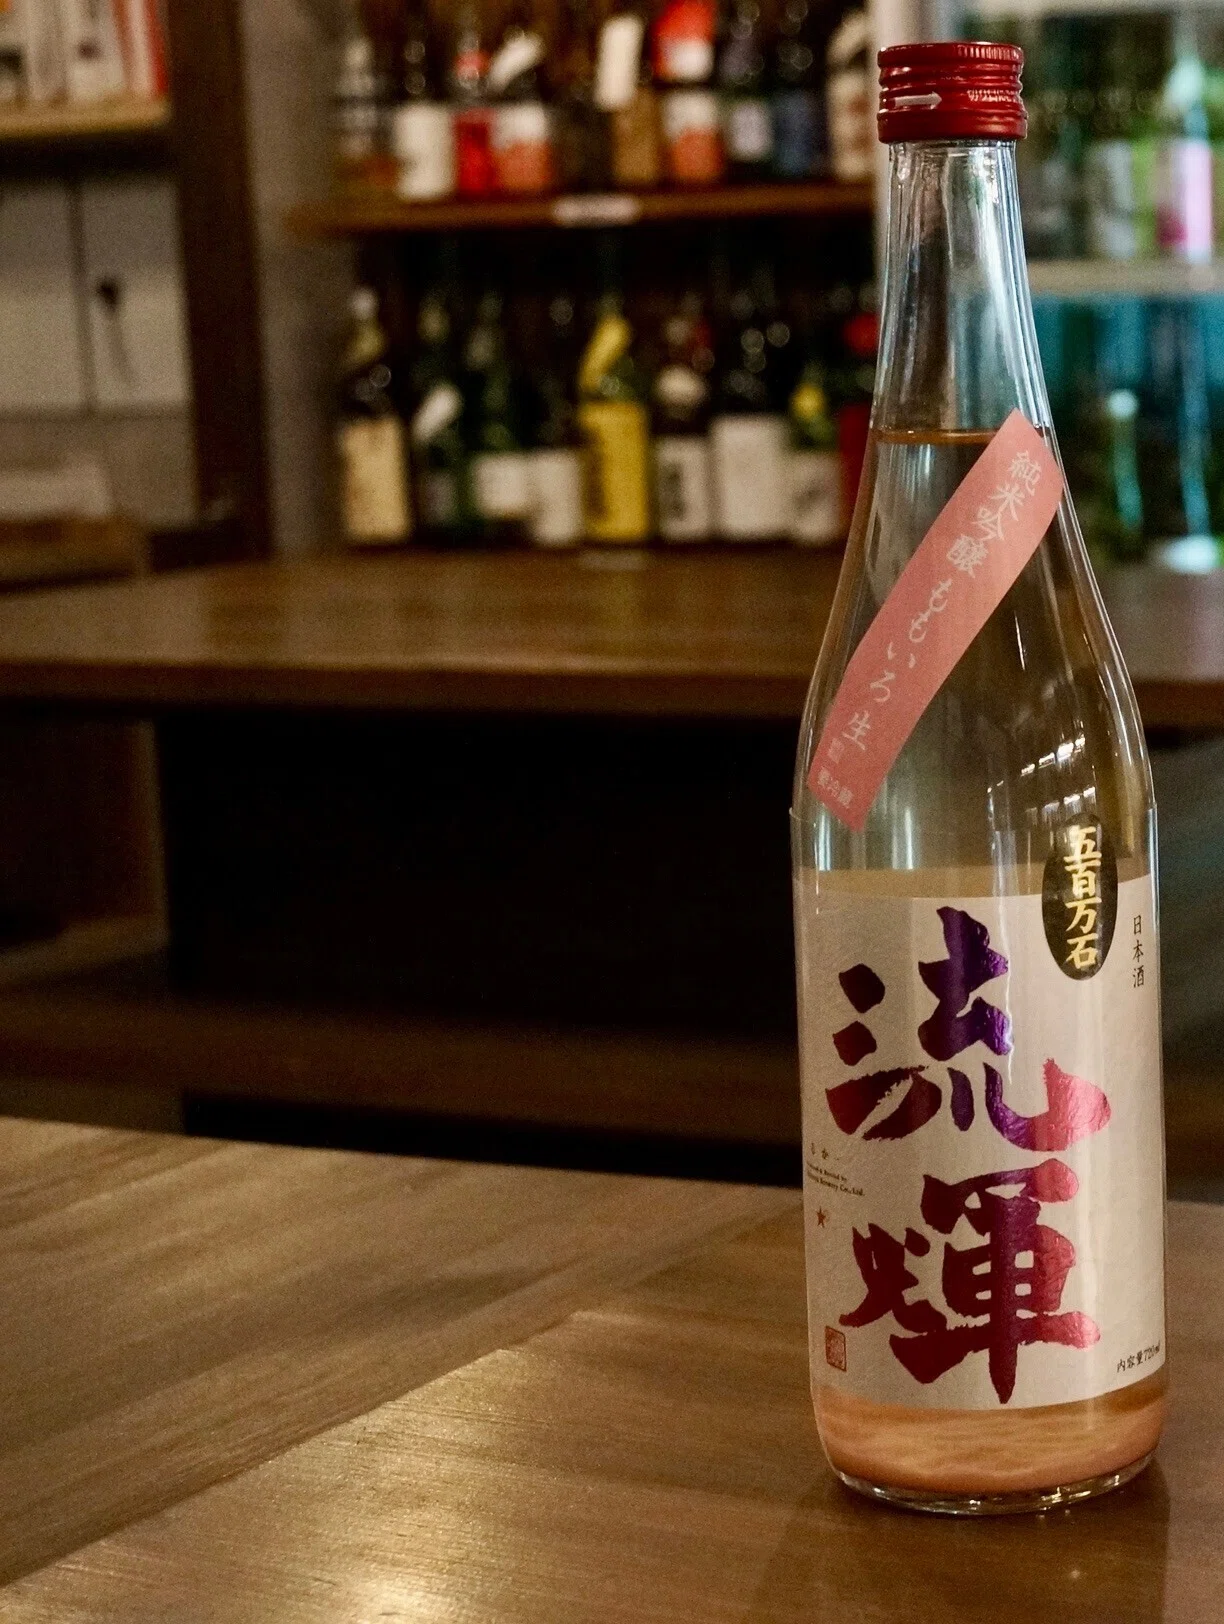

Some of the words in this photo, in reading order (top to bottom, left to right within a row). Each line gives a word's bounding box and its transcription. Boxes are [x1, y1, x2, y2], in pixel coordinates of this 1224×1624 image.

[1064, 825, 1102, 969] 五百万石
[1131, 914, 1145, 989] 日本酒
